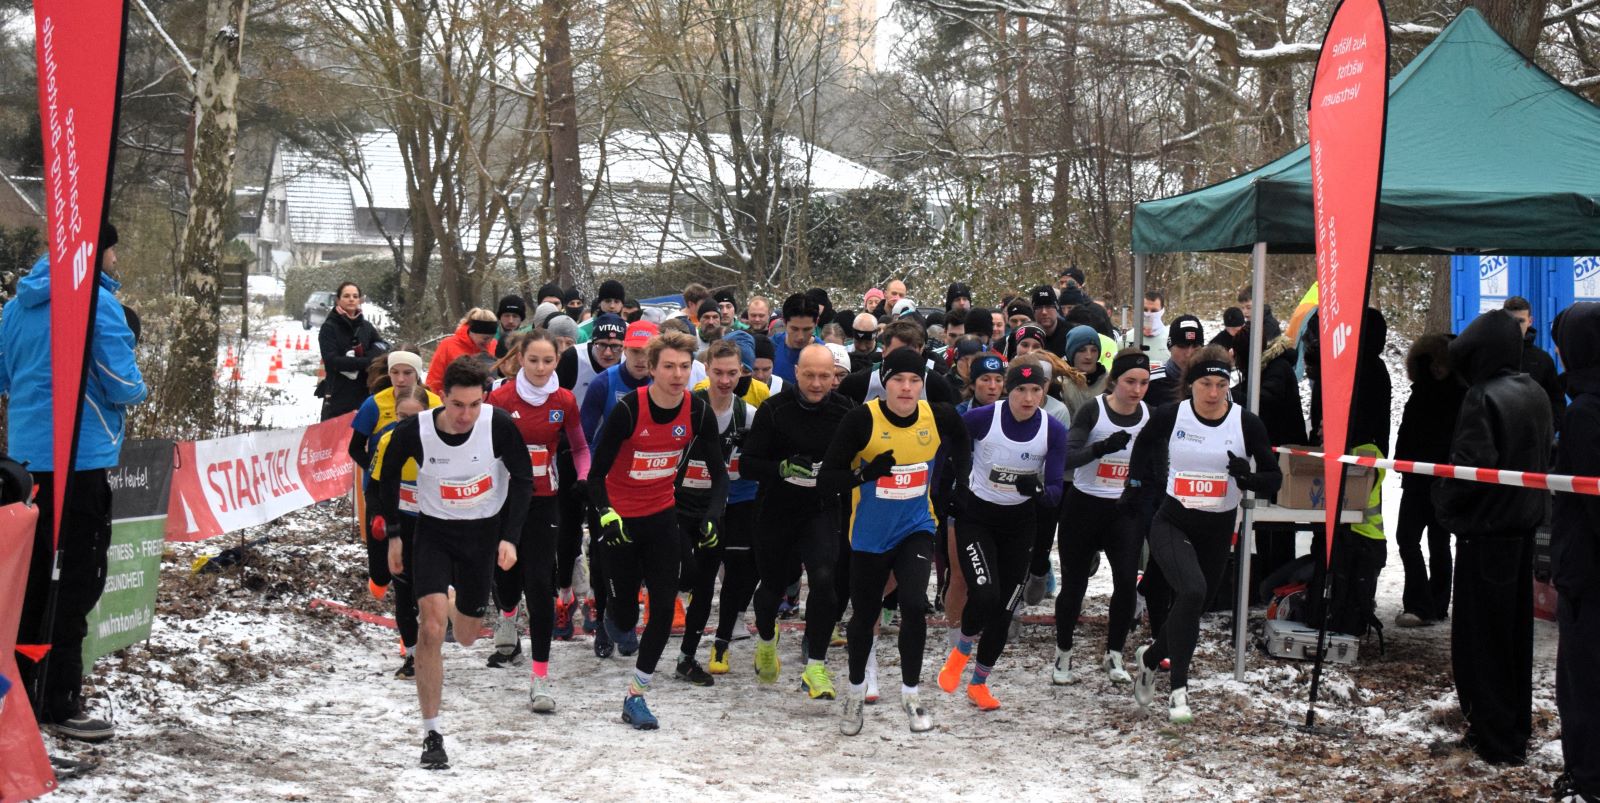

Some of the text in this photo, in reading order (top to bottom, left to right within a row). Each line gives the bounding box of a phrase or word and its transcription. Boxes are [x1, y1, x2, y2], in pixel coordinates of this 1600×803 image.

[646, 457, 668, 469] 109
[124, 466, 149, 490] heute!
[895, 474, 912, 485] 90
[455, 483, 480, 497] 106
[1188, 480, 1213, 493] 100
